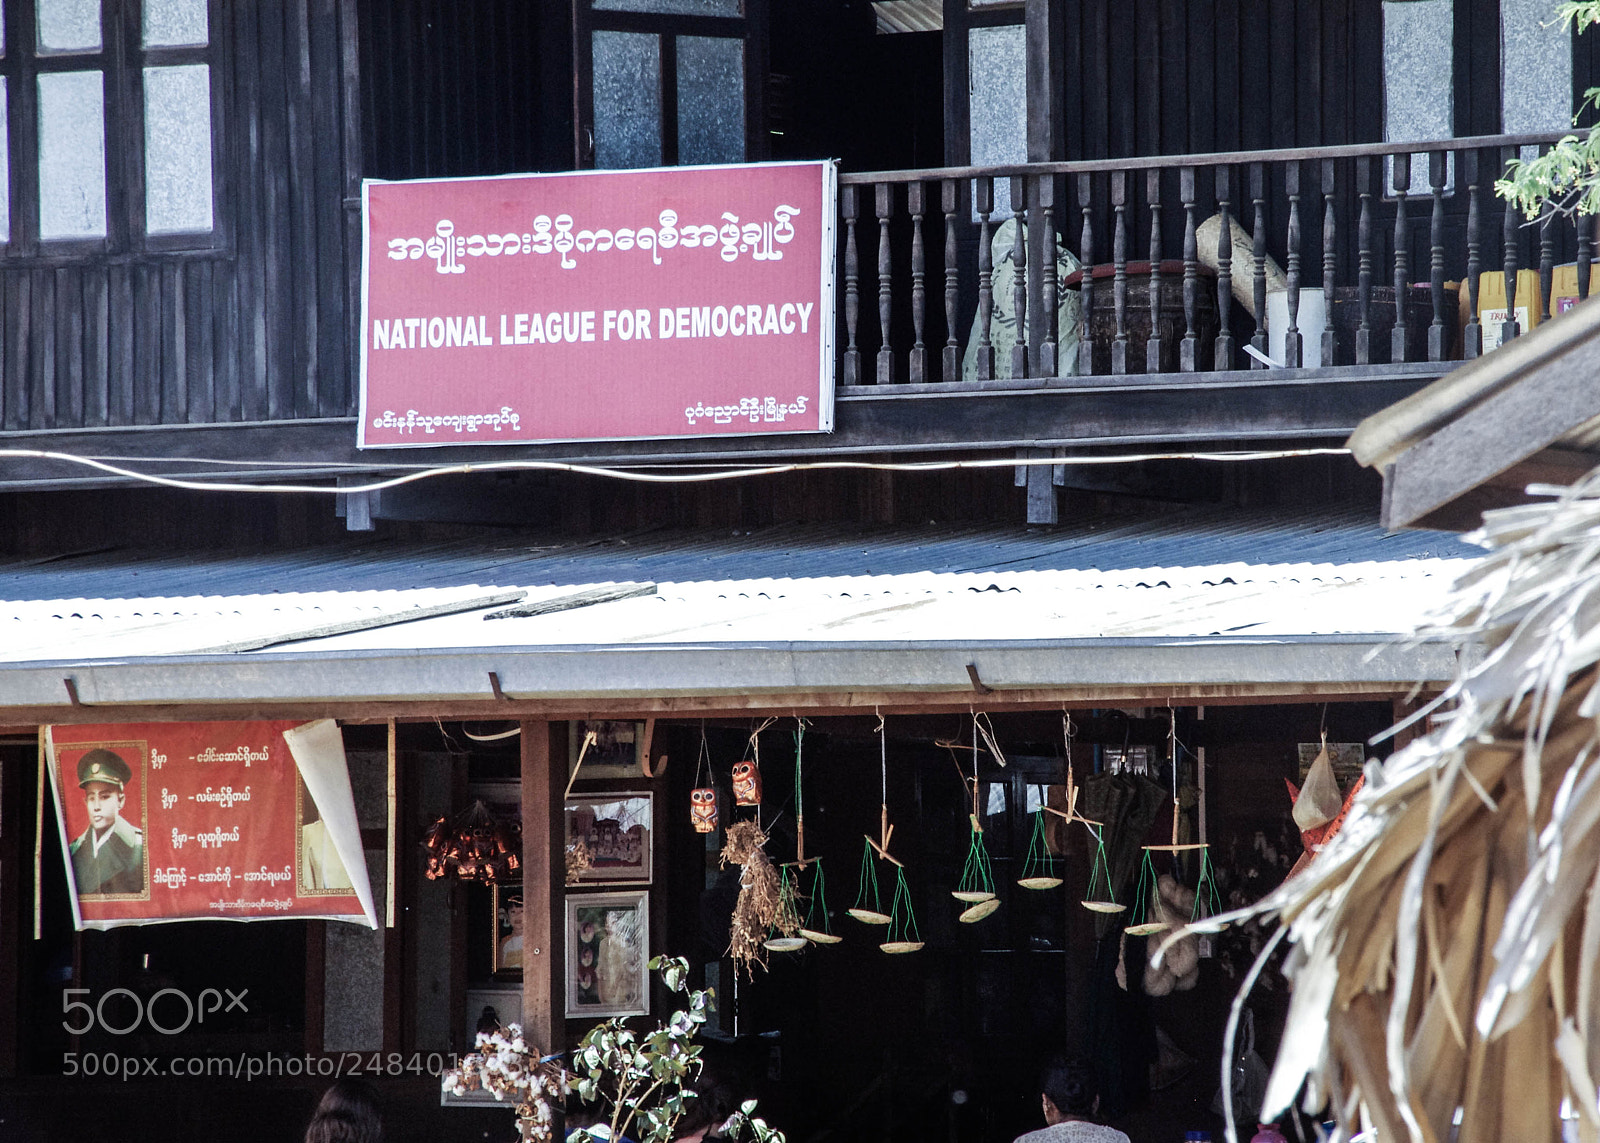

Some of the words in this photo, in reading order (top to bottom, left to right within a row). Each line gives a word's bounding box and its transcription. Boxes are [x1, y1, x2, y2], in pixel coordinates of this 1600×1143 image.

[387, 204, 801, 275] အမျိုးသားဒီမိုကရေစီအဖွဲ့ချုပ်
[373, 315, 493, 350] NATIONAL
[500, 310, 596, 346] LEAGUE
[603, 308, 652, 342] FOR
[658, 302, 814, 339] DEMOCRACY
